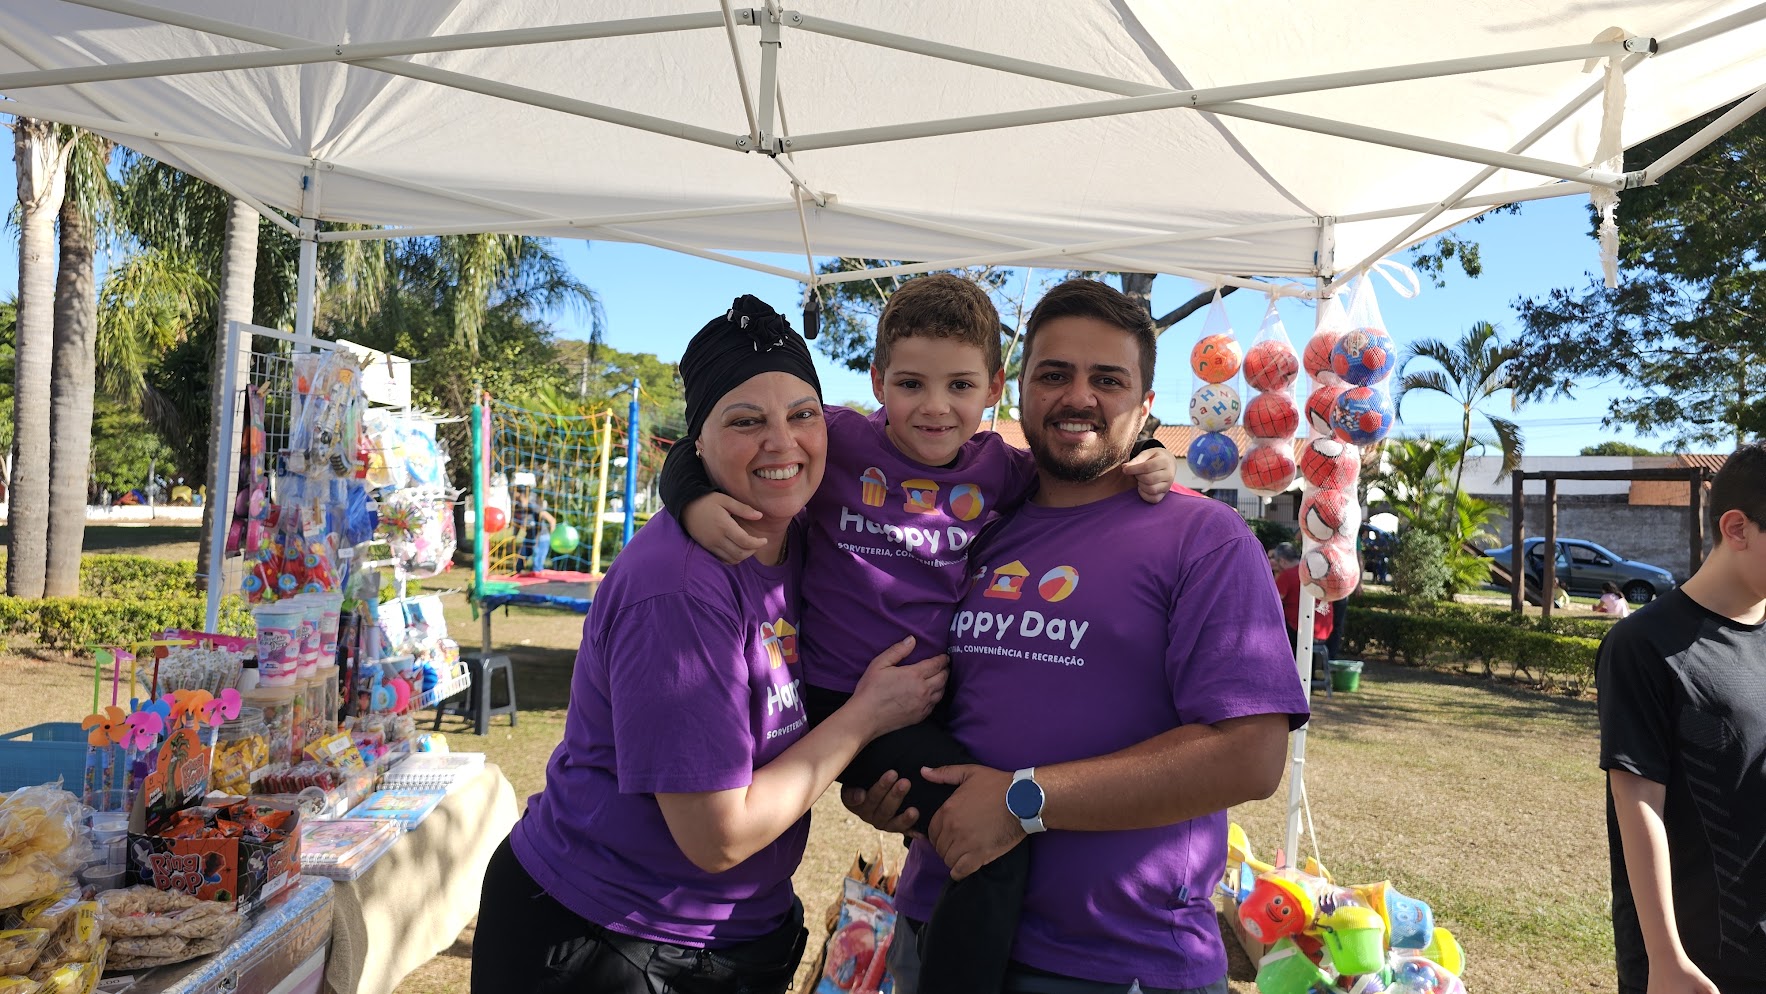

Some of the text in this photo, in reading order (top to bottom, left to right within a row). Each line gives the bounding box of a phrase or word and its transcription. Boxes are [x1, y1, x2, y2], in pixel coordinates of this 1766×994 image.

[839, 505, 940, 554] Happy
[1020, 610, 1090, 650] Day
[963, 644, 1023, 659] CONVENIÊNCIA
[1025, 651, 1030, 660] E
[1031, 652, 1085, 667] RECREAÇÃO
[149, 851, 201, 875] Ring
